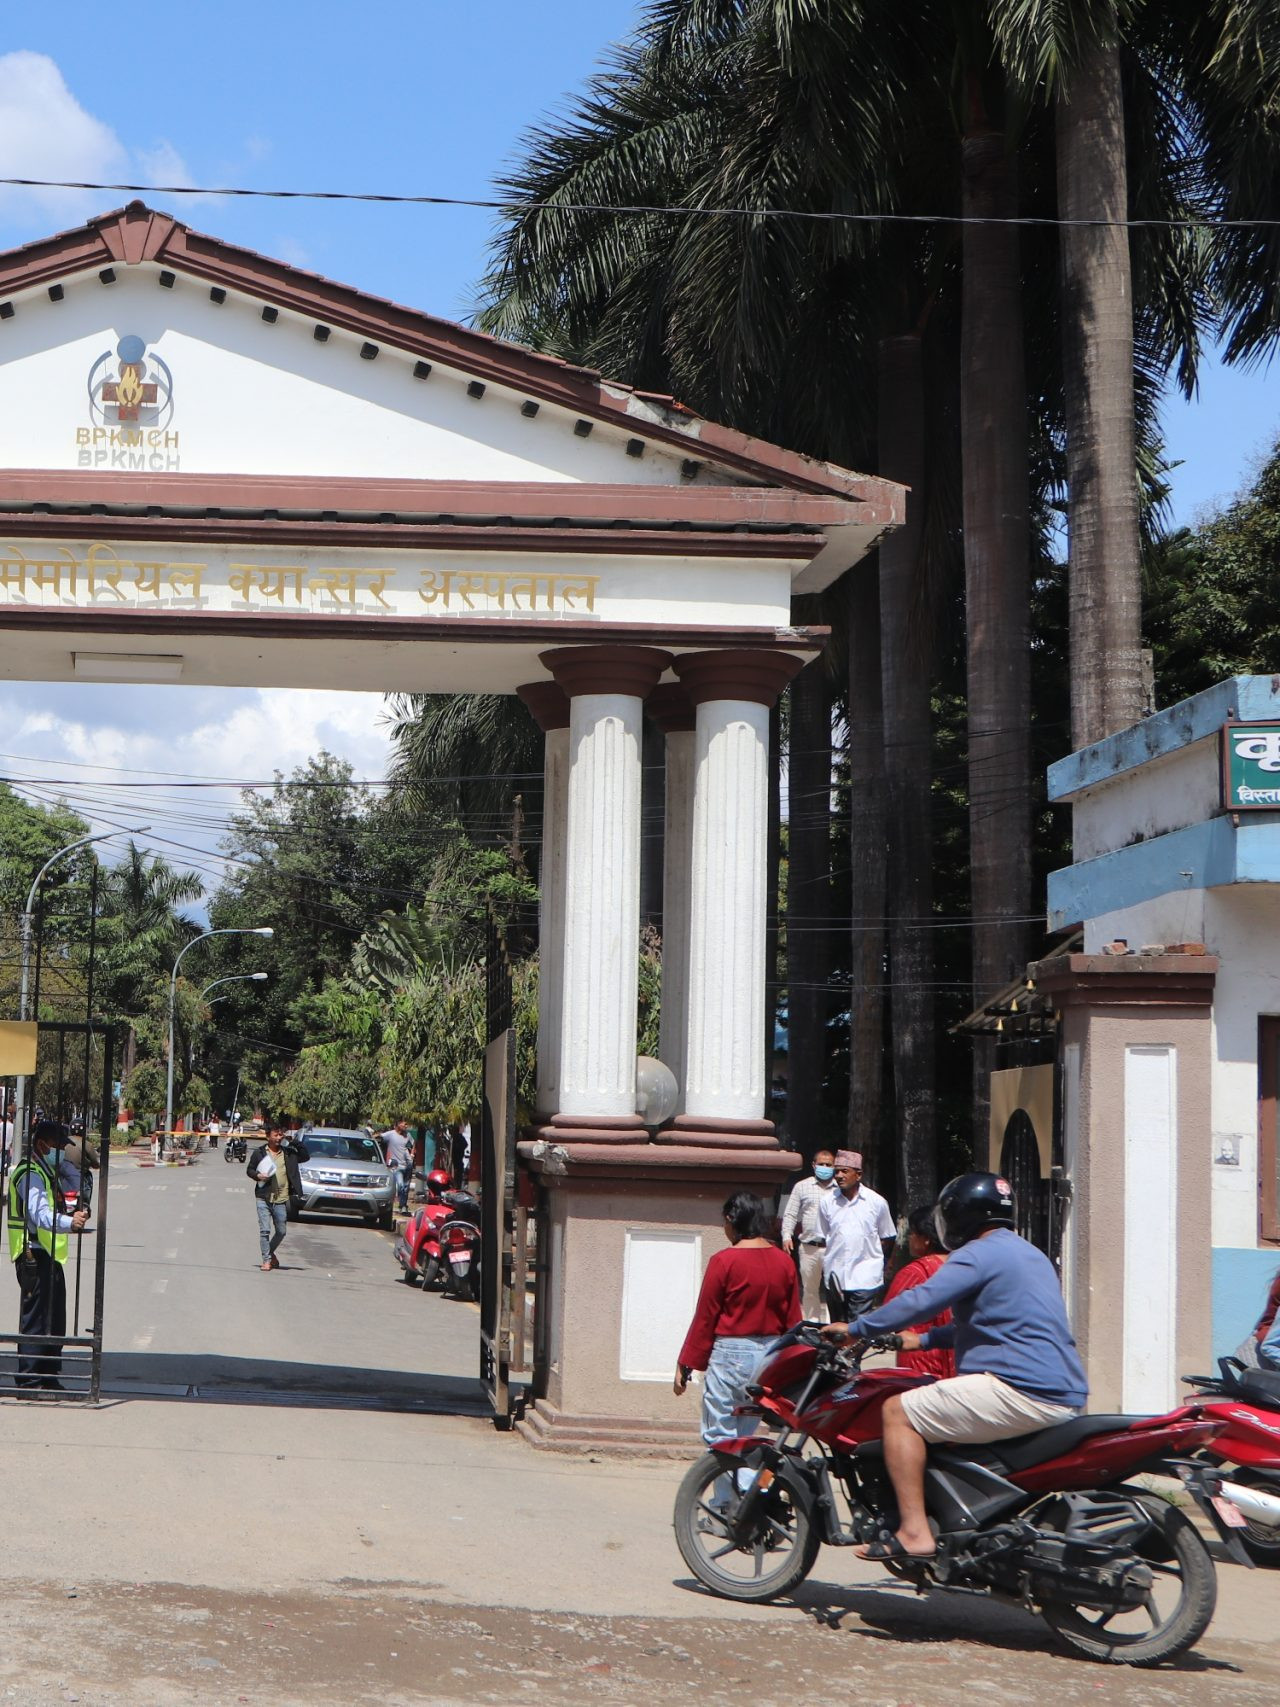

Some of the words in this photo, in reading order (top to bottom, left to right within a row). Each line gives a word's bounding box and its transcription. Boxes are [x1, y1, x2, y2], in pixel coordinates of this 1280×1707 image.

[76, 427, 179, 449] BPKMCH
[228, 563, 397, 610] क्यान्सर
[418, 569, 601, 612] अस्पताल
